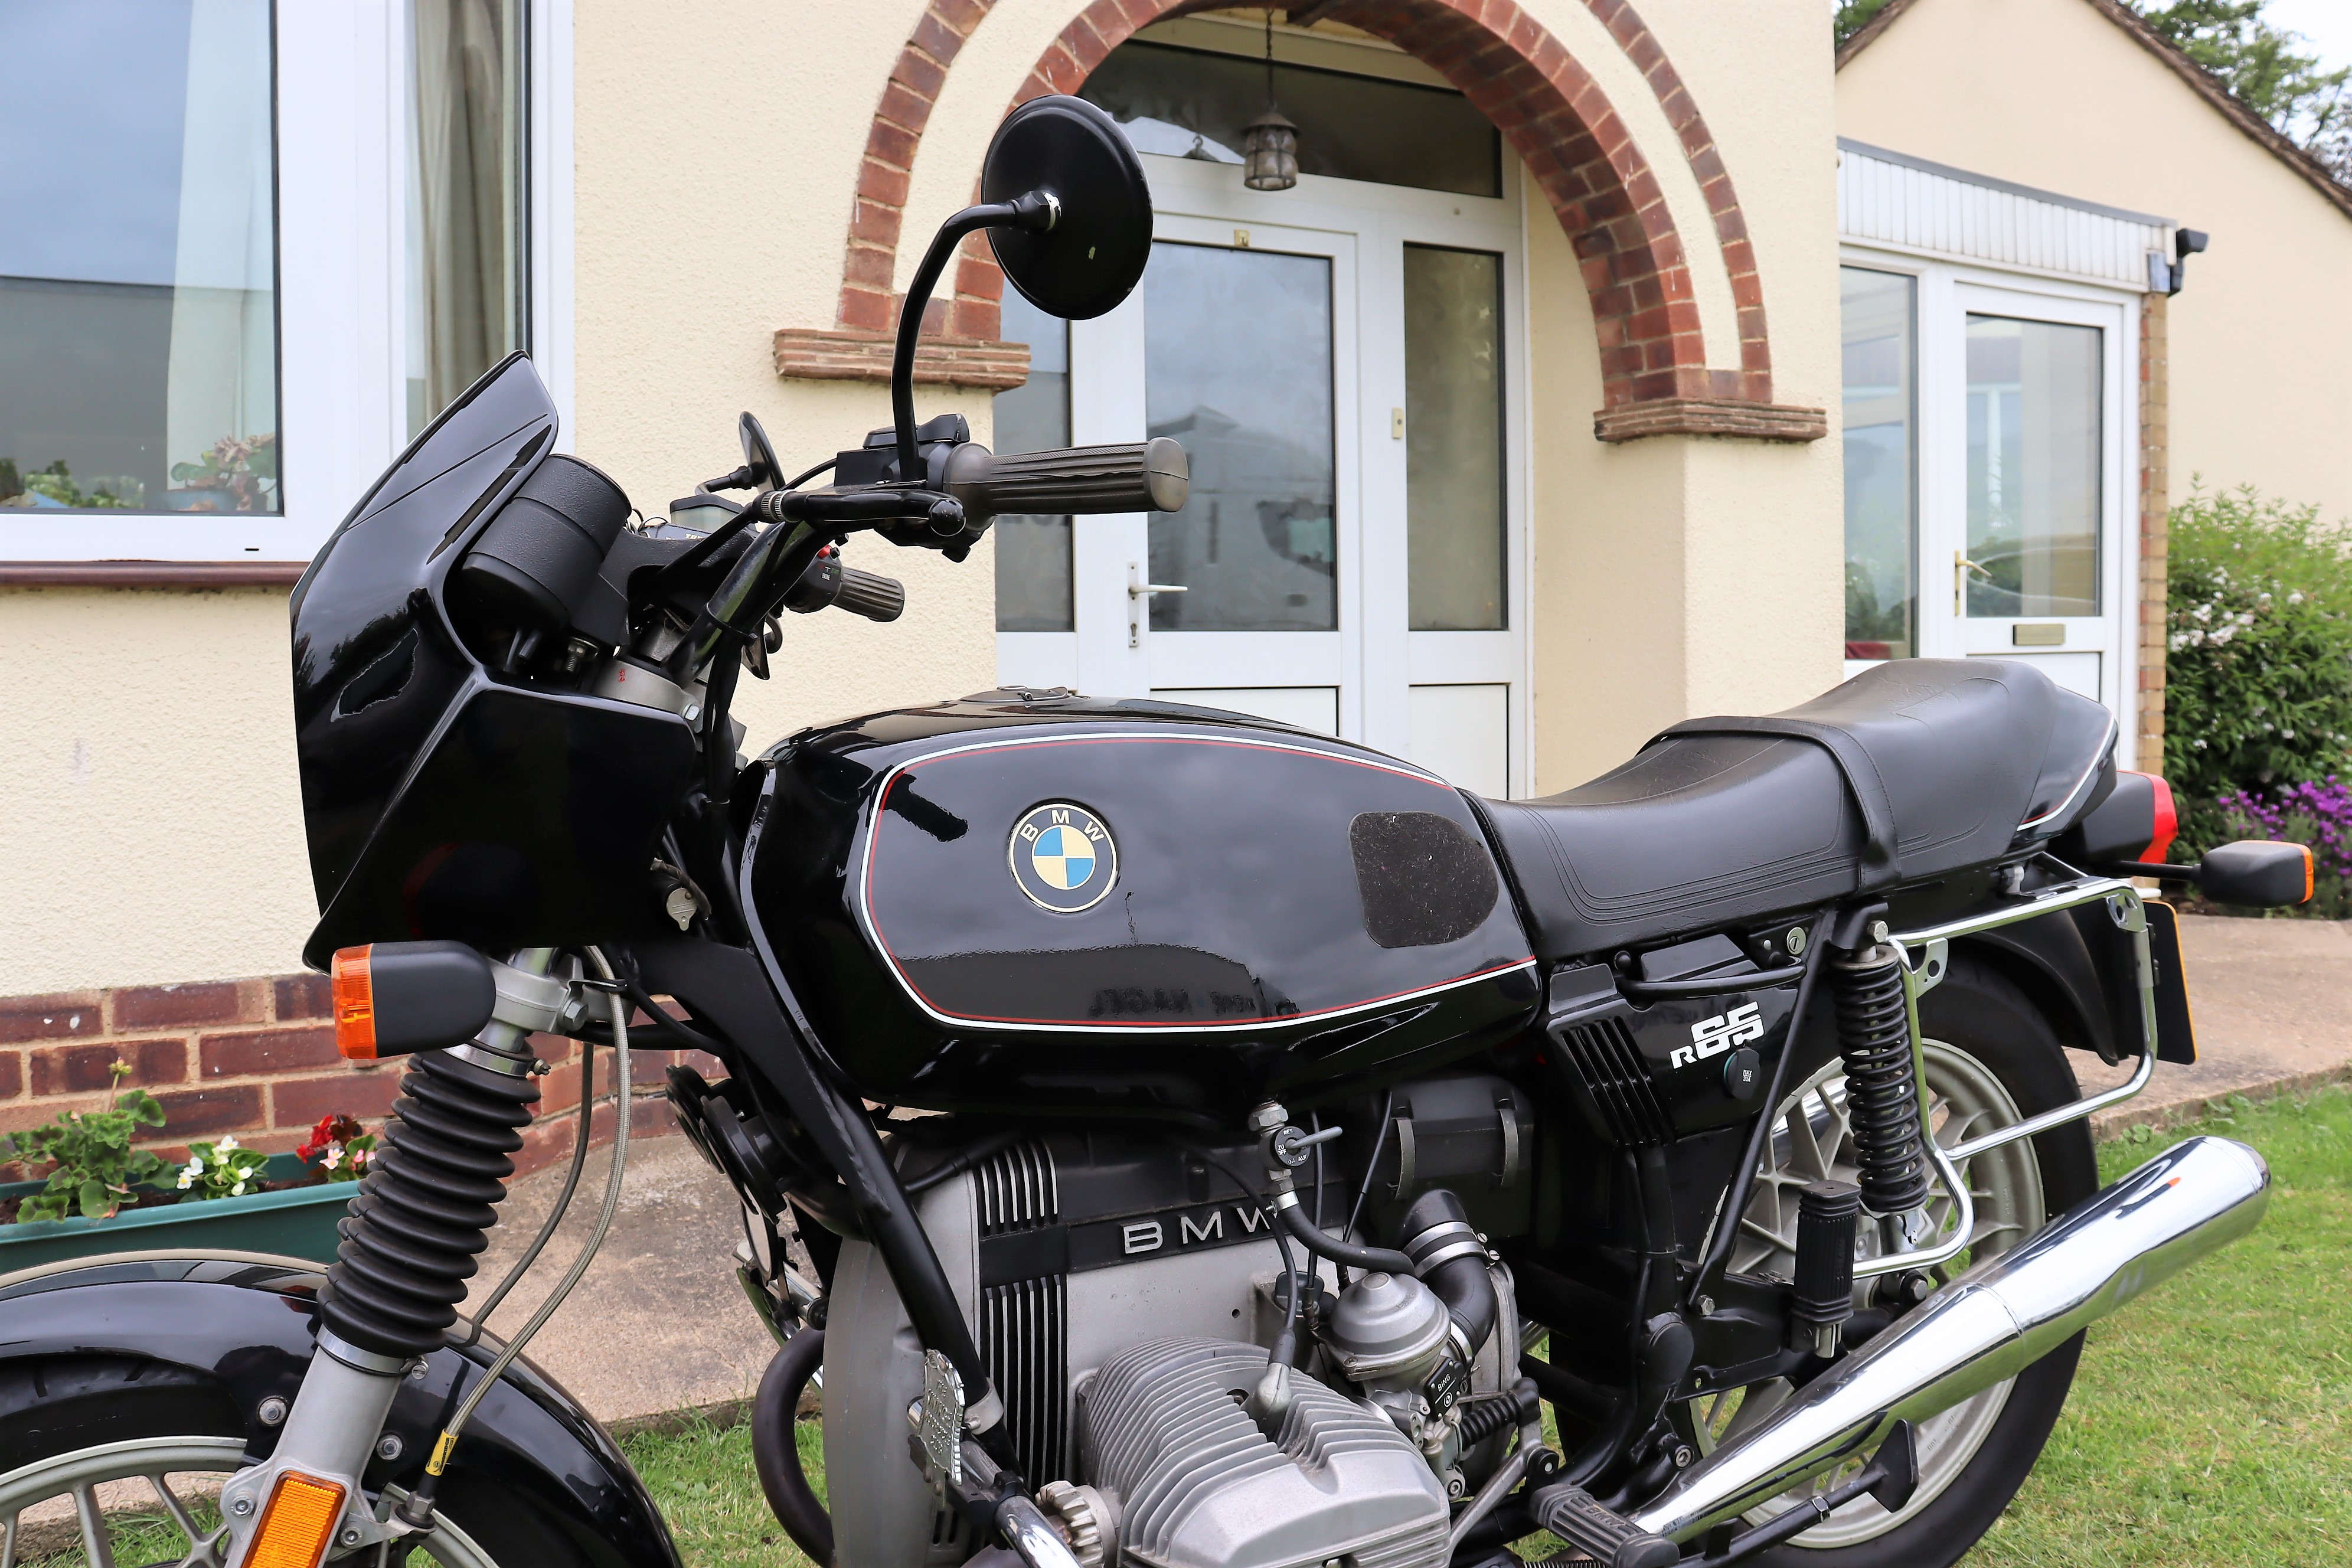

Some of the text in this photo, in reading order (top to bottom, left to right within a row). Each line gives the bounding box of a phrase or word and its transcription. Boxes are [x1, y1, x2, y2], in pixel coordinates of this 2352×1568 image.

[1020, 809, 1105, 842] BMW
[1670, 1001, 1764, 1069] R65
[1123, 1207, 1270, 1254] BMW
[1438, 1373, 1451, 1392] BING
